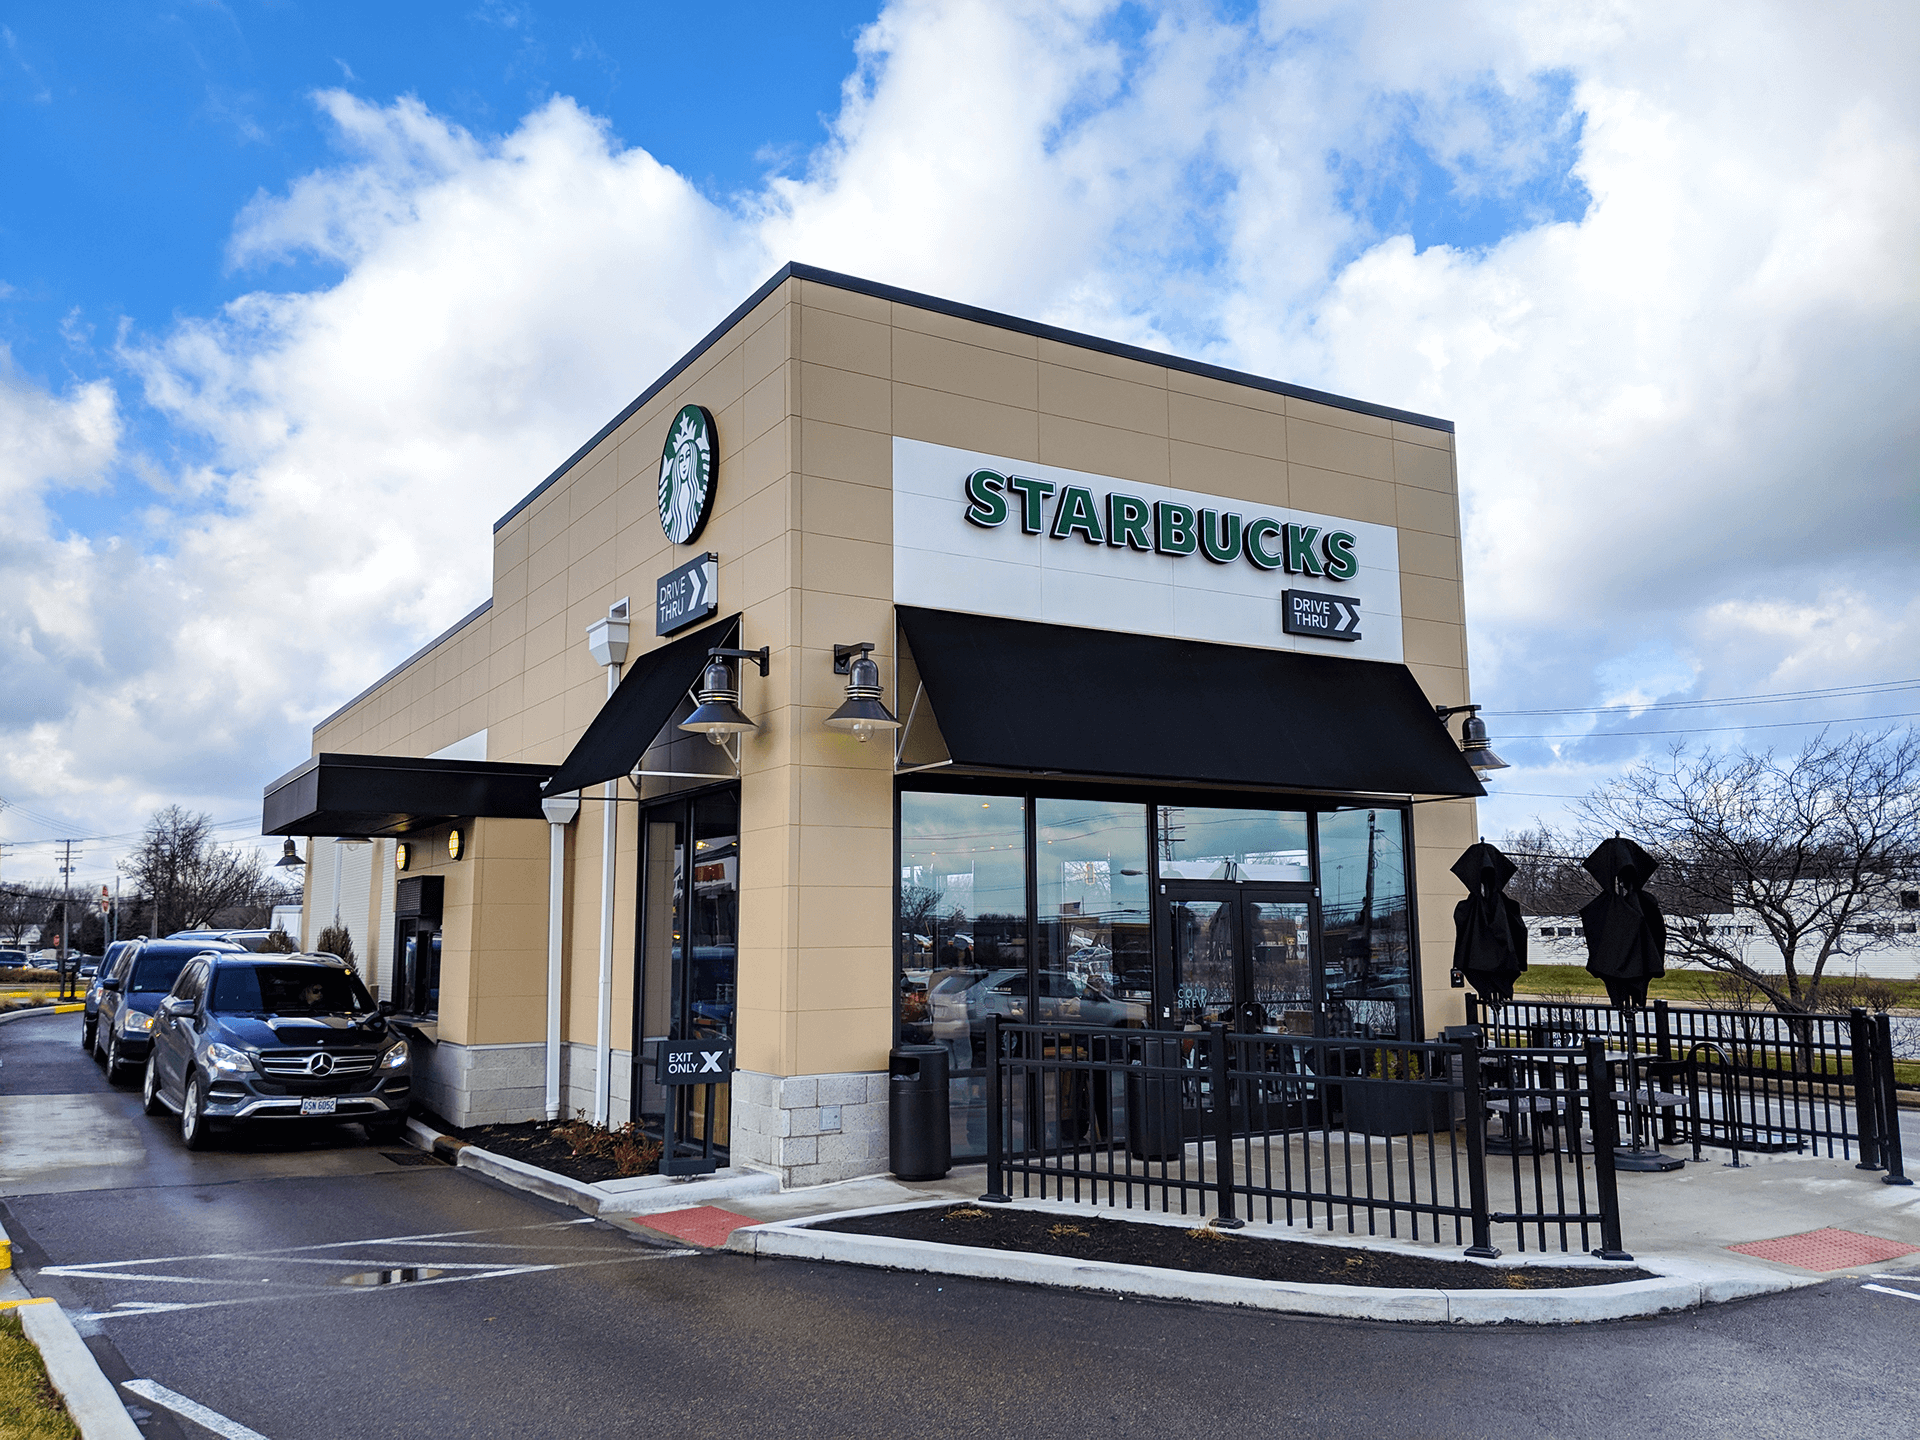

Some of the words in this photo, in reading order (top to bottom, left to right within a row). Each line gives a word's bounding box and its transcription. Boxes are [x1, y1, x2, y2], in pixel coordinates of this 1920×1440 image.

[965, 469, 1359, 580] STARBUCKS
[660, 576, 686, 605] DRIVE
[660, 597, 684, 623] THRU
[1293, 597, 1331, 615] DRIVE
[1294, 612, 1328, 629] THRU
[1178, 988, 1207, 999] COLD
[1177, 999, 1207, 1009] BREW
[668, 1052, 693, 1063] EXIT
[668, 1063, 698, 1074] ONLY
[318, 1100, 335, 1110] 6052
